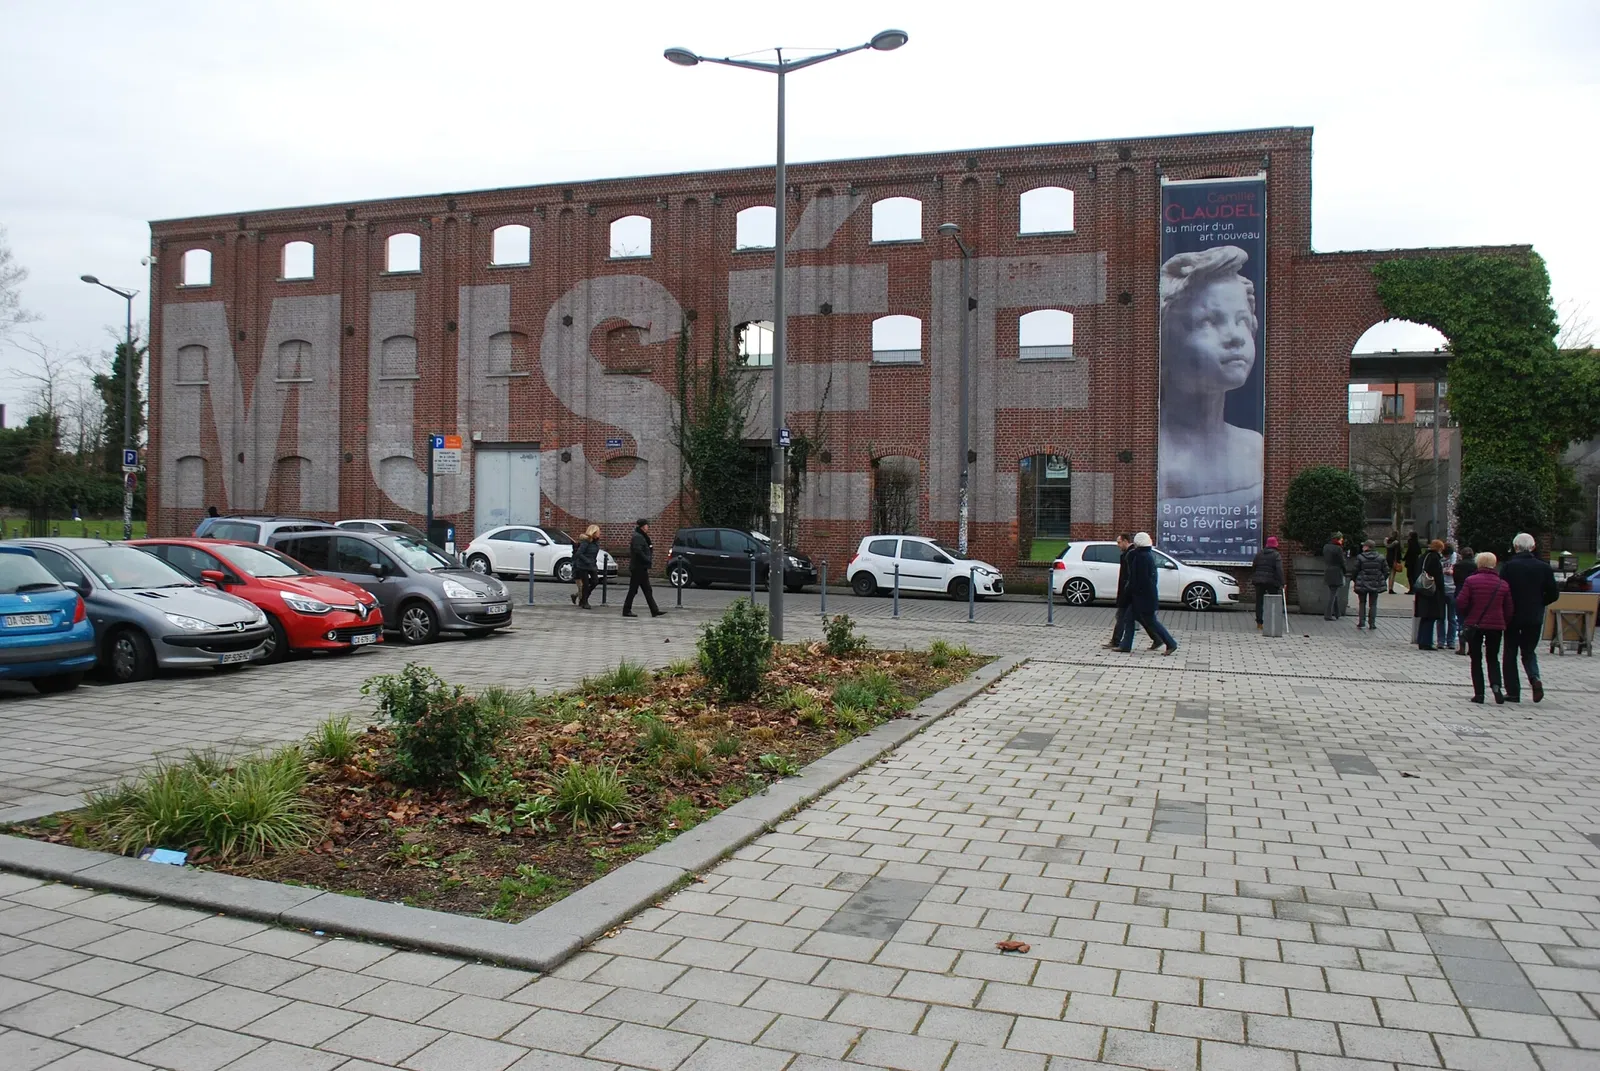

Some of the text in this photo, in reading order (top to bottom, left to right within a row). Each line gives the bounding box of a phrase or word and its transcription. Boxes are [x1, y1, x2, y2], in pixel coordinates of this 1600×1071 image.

[1207, 192, 1256, 203] Camille
[1165, 203, 1260, 223] CLAUDEL
[1165, 222, 1235, 234] au miroir d'un
[1199, 231, 1260, 242] art nouveau
[1163, 504, 1258, 516] 8 novembre 14
[1163, 516, 1258, 529] au 8 février 15
